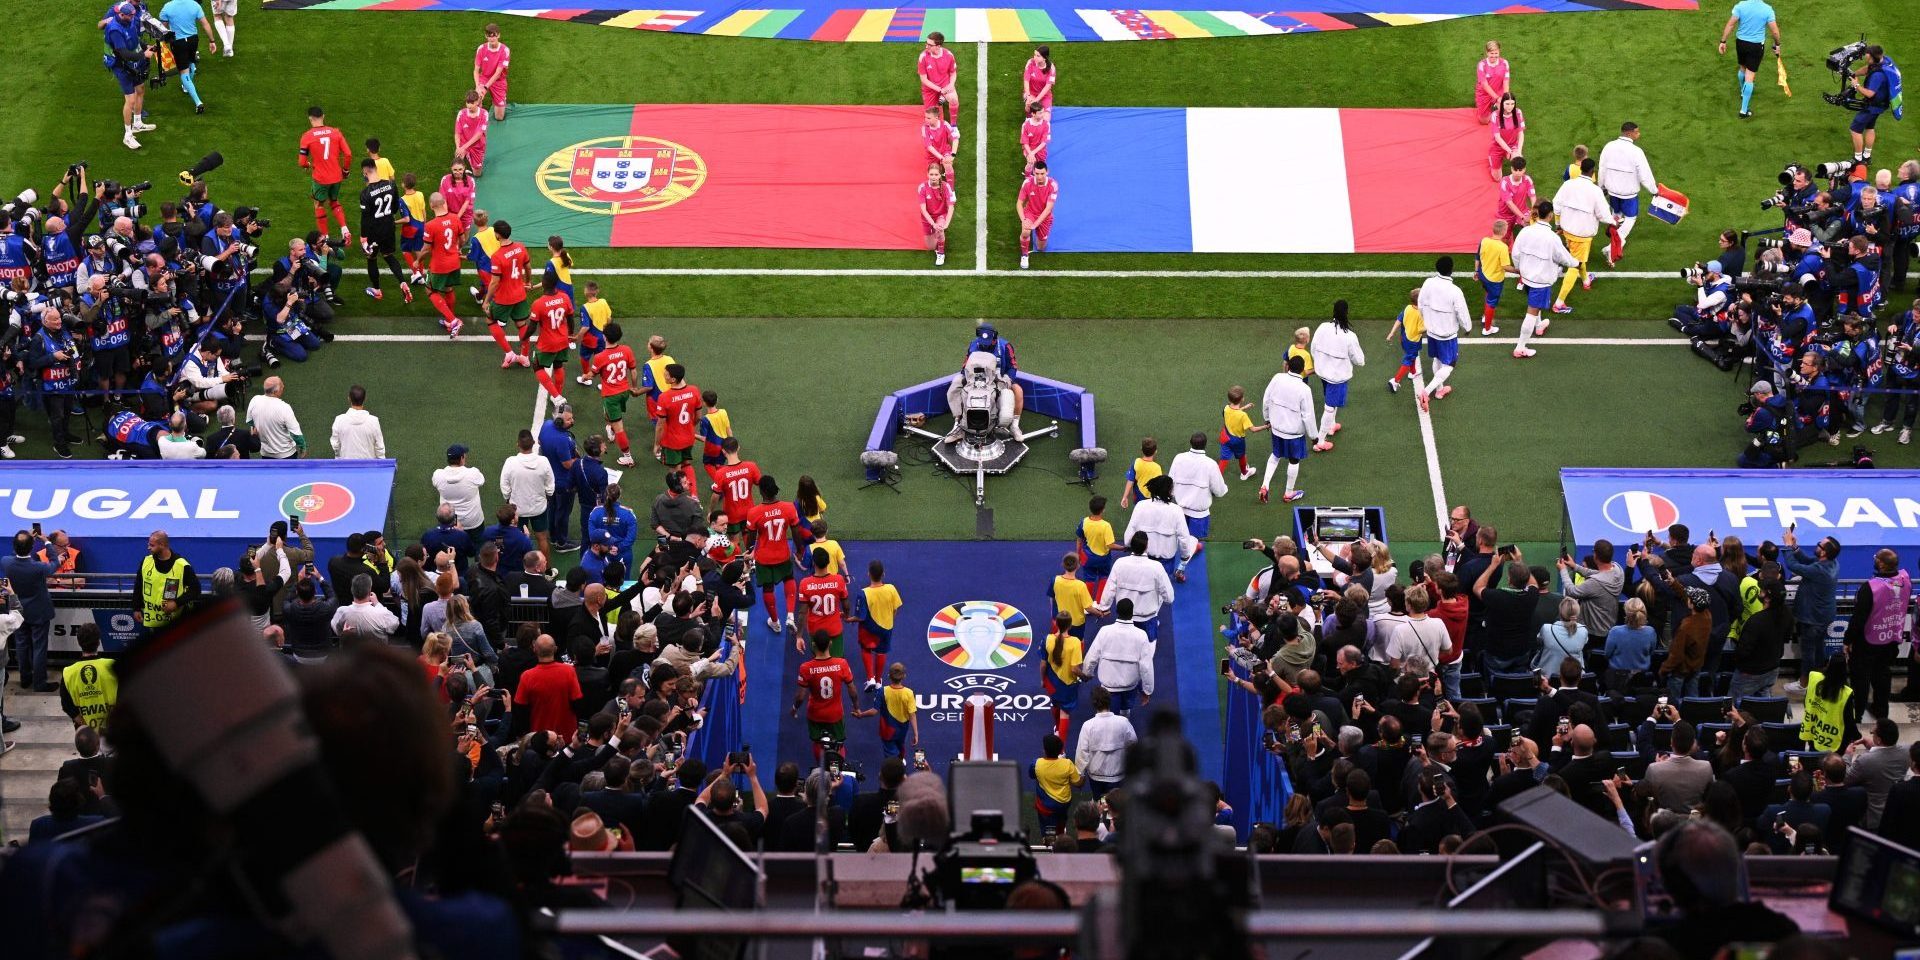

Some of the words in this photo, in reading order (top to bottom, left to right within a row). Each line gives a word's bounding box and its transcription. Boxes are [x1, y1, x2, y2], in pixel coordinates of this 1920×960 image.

[320, 136, 331, 160] 7
[374, 193, 393, 219] 22
[444, 227, 453, 251] 3
[0, 267, 25, 278] HOTO
[46, 259, 77, 275] PHOTO
[511, 258, 520, 280] 4
[107, 319, 126, 334] OTO
[547, 307, 566, 330] 19
[95, 332, 128, 348] 06-096
[606, 360, 628, 384] 23
[678, 402, 691, 425] 6
[728, 477, 749, 502] 10
[0, 488, 241, 520] UGAL
[763, 518, 786, 541] 17
[810, 593, 836, 616] 20
[820, 676, 834, 699] 8
[947, 676, 1010, 692] UEFA
[930, 712, 1029, 722] GEANY
